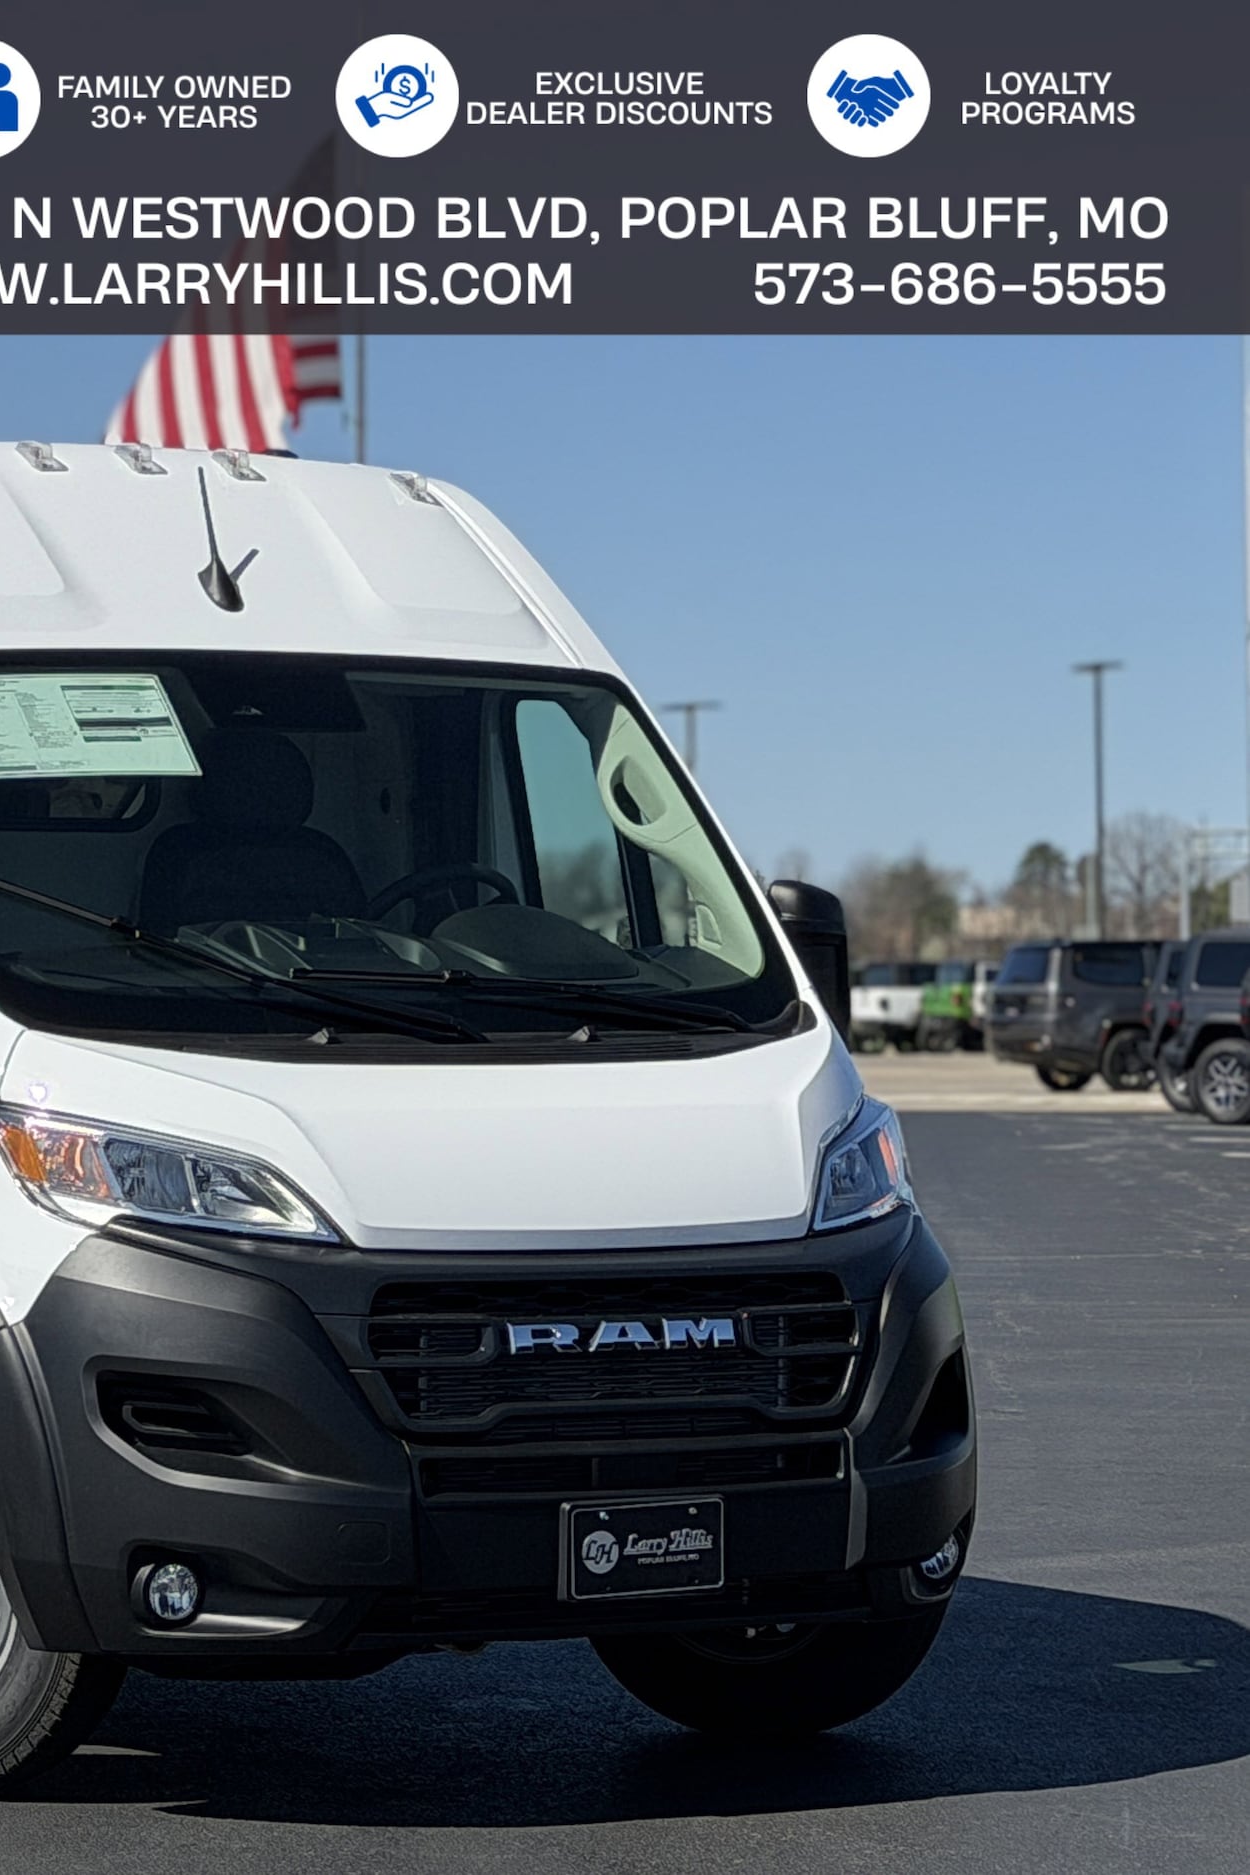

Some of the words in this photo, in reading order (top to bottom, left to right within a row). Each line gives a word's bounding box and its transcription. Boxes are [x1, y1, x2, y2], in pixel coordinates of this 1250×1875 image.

[507, 1317, 736, 1354] RAM
[623, 1533, 668, 1555] Larry
[669, 1528, 713, 1551] Hillis
